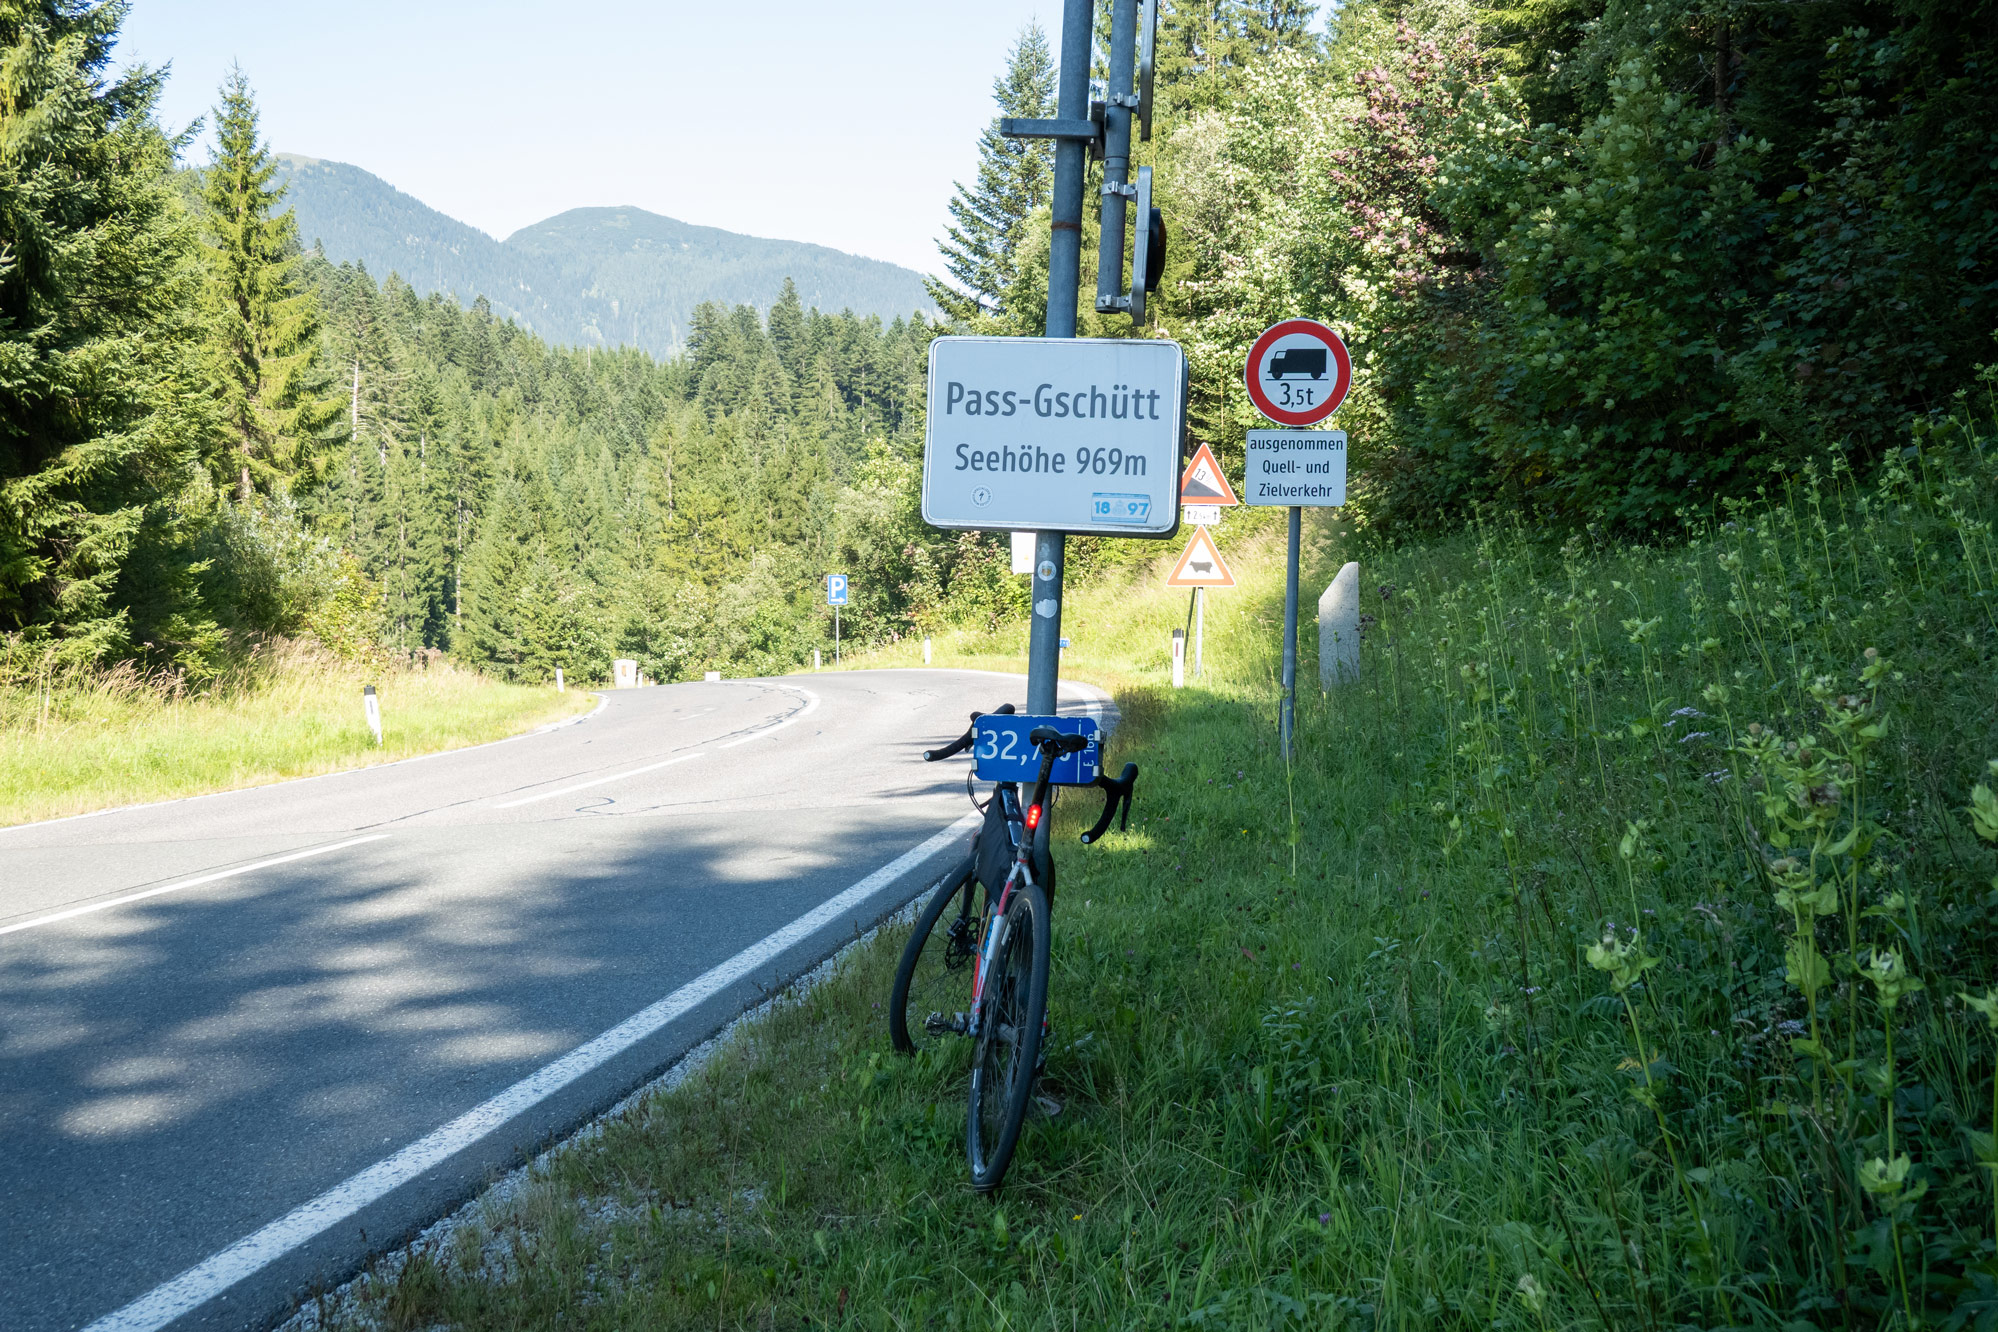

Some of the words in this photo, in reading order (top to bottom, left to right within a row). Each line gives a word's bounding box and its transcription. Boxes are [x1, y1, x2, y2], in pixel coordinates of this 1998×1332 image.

[946, 381, 1160, 420] Pass-Gschütt
[1279, 382, 1314, 408] 3,5t
[1250, 439, 1344, 453] ausgenommen
[955, 443, 1066, 474] Seehöhe
[1076, 447, 1147, 476] 969m
[1262, 460, 1302, 474] Quell-
[1305, 460, 1330, 474] und
[1258, 482, 1333, 498] Zielverkehr
[1094, 501, 1111, 515] 18
[1127, 502, 1150, 517] 97
[831, 577, 845, 598] P
[981, 729, 1072, 766] 32,
